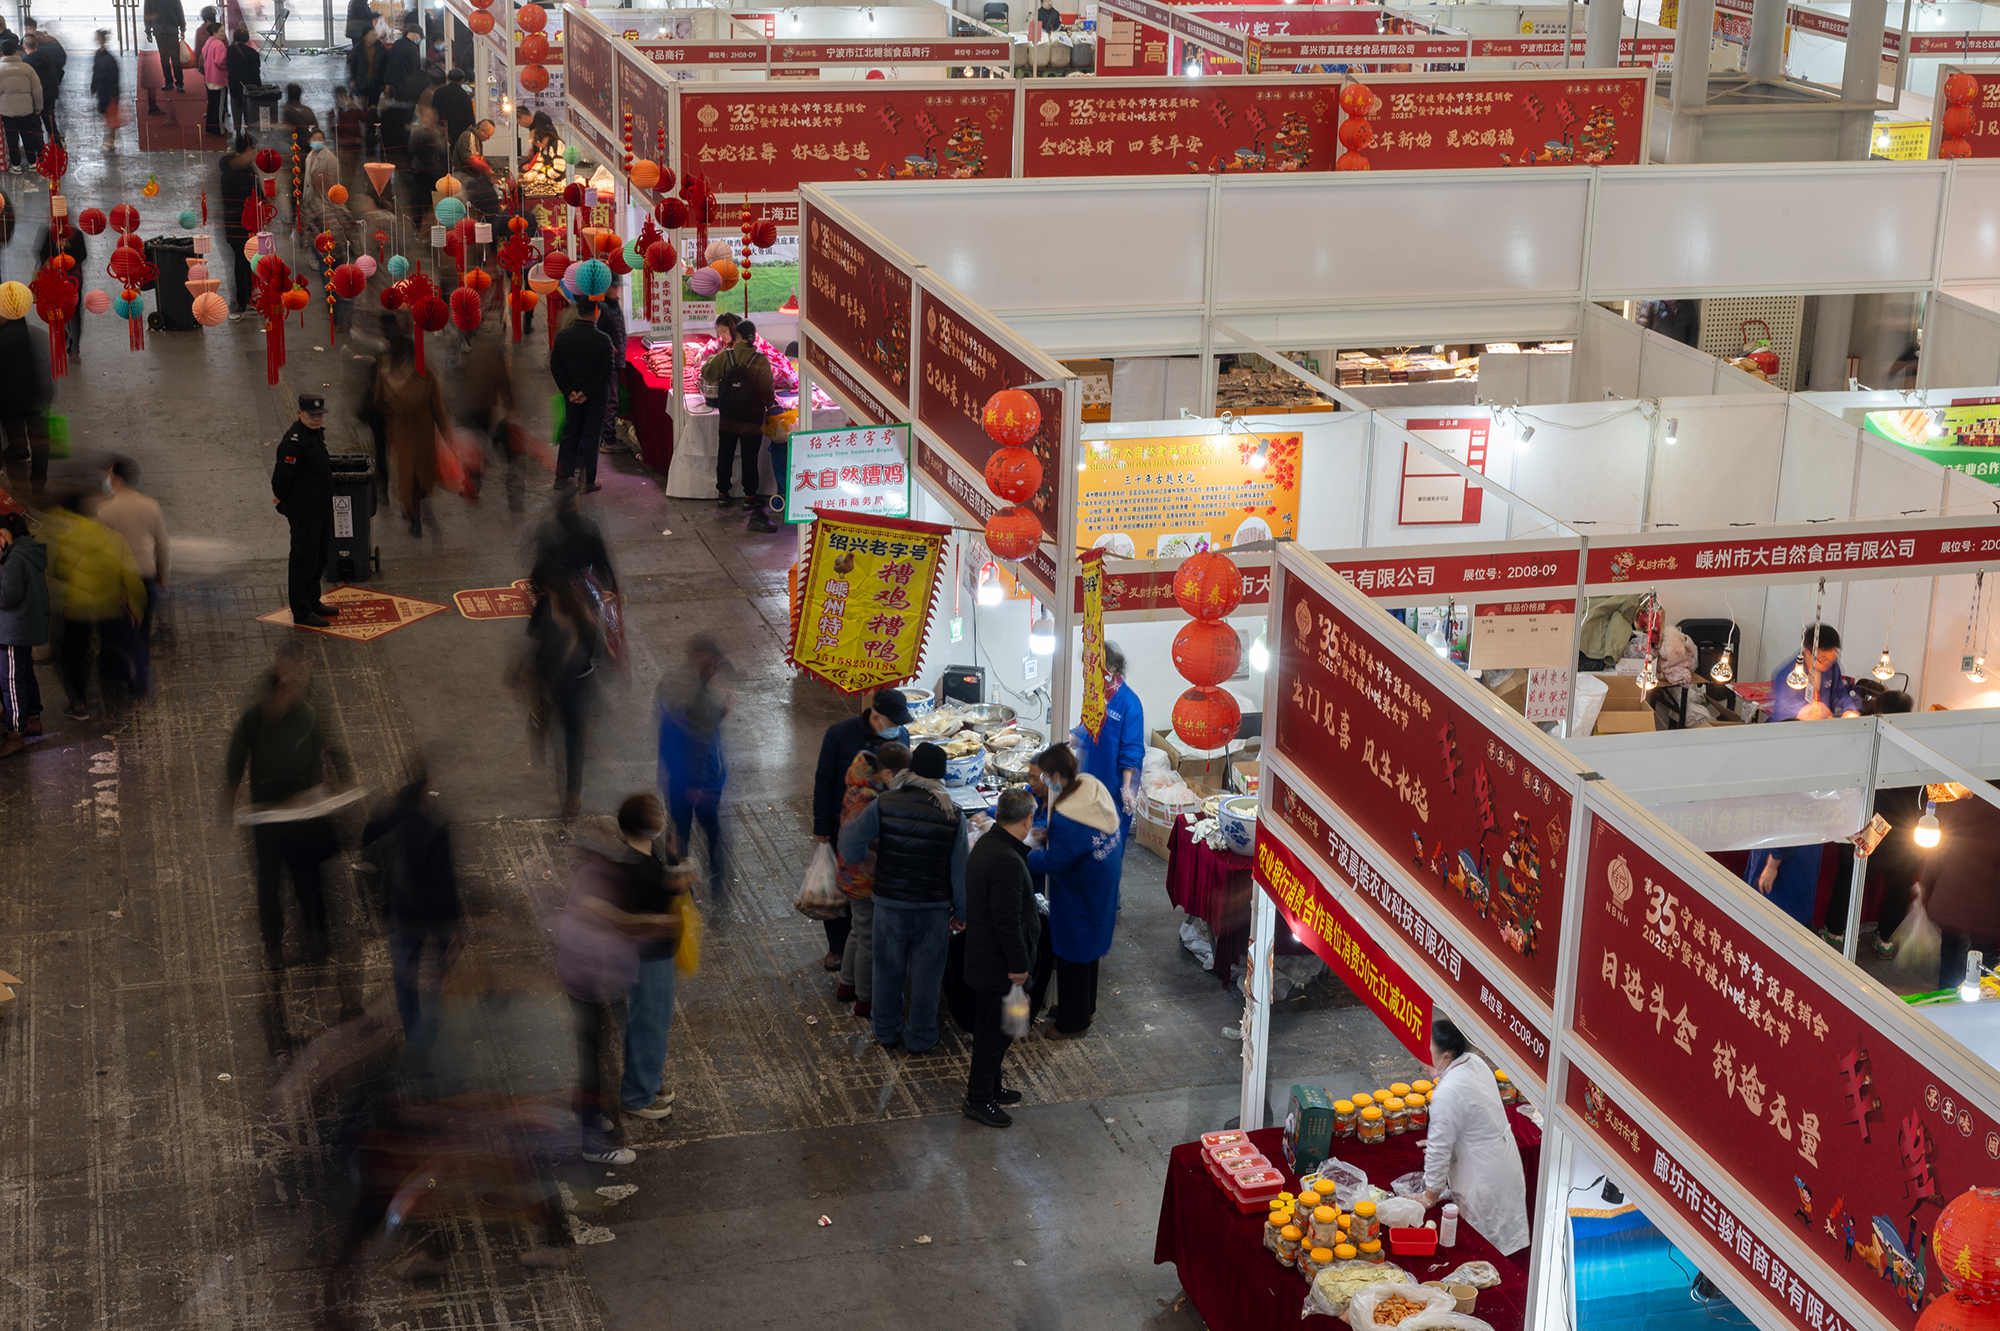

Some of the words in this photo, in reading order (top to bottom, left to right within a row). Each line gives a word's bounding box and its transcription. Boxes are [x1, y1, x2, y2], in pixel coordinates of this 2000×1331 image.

[642, 49, 685, 61] 食品商行
[826, 47, 931, 59] 宁波市江北糖翁食品商行
[1300, 44, 1415, 56] 嘉兴市真真老老食品有限公司
[757, 103, 866, 114] 宁波市春节年货展销会
[1096, 98, 1200, 109] 宁波市春节年货展销会
[1416, 92, 1514, 104] 宁波市春节年货展销会
[1069, 118, 1095, 126] 2025年
[1391, 112, 1415, 120] 2025年
[729, 124, 756, 132] 2025年
[1446, 128, 1515, 148] 灵蛇赐福
[1973, 120, 2000, 137] 门见
[697, 142, 778, 165] 金蛇狂舞
[792, 141, 871, 162] 好运连连
[1038, 136, 1115, 157] 金蛇接财
[1128, 134, 1204, 159] 四季平安
[758, 207, 798, 221] 上海正
[986, 409, 1020, 428] 新春
[810, 429, 894, 450] 绍兴老字号
[795, 464, 904, 491] 大自然糟鸡
[814, 496, 884, 509] 绍兴市商务局
[828, 533, 928, 561] 绍兴老字号
[1636, 556, 1679, 571] 发财市集
[1695, 538, 1916, 570] 嵊州市大自然食品有限公司
[1030, 554, 1056, 582] 号：2D08-09
[1463, 564, 1557, 582] 展位号：2D08-09
[1182, 580, 1226, 605] 新春
[1242, 574, 1271, 596] 市大
[813, 579, 849, 653] 嵊州特产
[863, 561, 917, 662] 糟鸡糟鸭
[1504, 602, 1546, 613] 商品价格牌
[1294, 638, 1311, 655] NBNH
[816, 653, 896, 671] 15158250188
[1340, 631, 1432, 722] 宁波市春节年货展销会
[1317, 650, 1339, 677] 2025年
[1341, 661, 1410, 731] 暨宁波小吃美食节
[1292, 674, 1351, 751] 出门见喜
[1361, 736, 1431, 823] 风生水起
[1605, 901, 1629, 927] NBNH
[1258, 842, 1423, 1042] 农业银行消费合作展位消费50元立减20元
[1328, 831, 1463, 982] 宁波晨皓农业科技有限公司
[1479, 985, 1545, 1058] 展位号：2C08-09
[1680, 906, 1829, 1042] 宁波市春节年货展销会
[1642, 924, 1675, 961] 2025年
[1681, 940, 1792, 1048] 暨宁波小吃美食节
[1601, 947, 1699, 1056] 日进斗金
[1712, 1039, 1821, 1169] 钱途无量
[1985, 1131, 2000, 1160] 囤
[1653, 1149, 1849, 1331] 廊坊市兰骏恒商贸有限公
